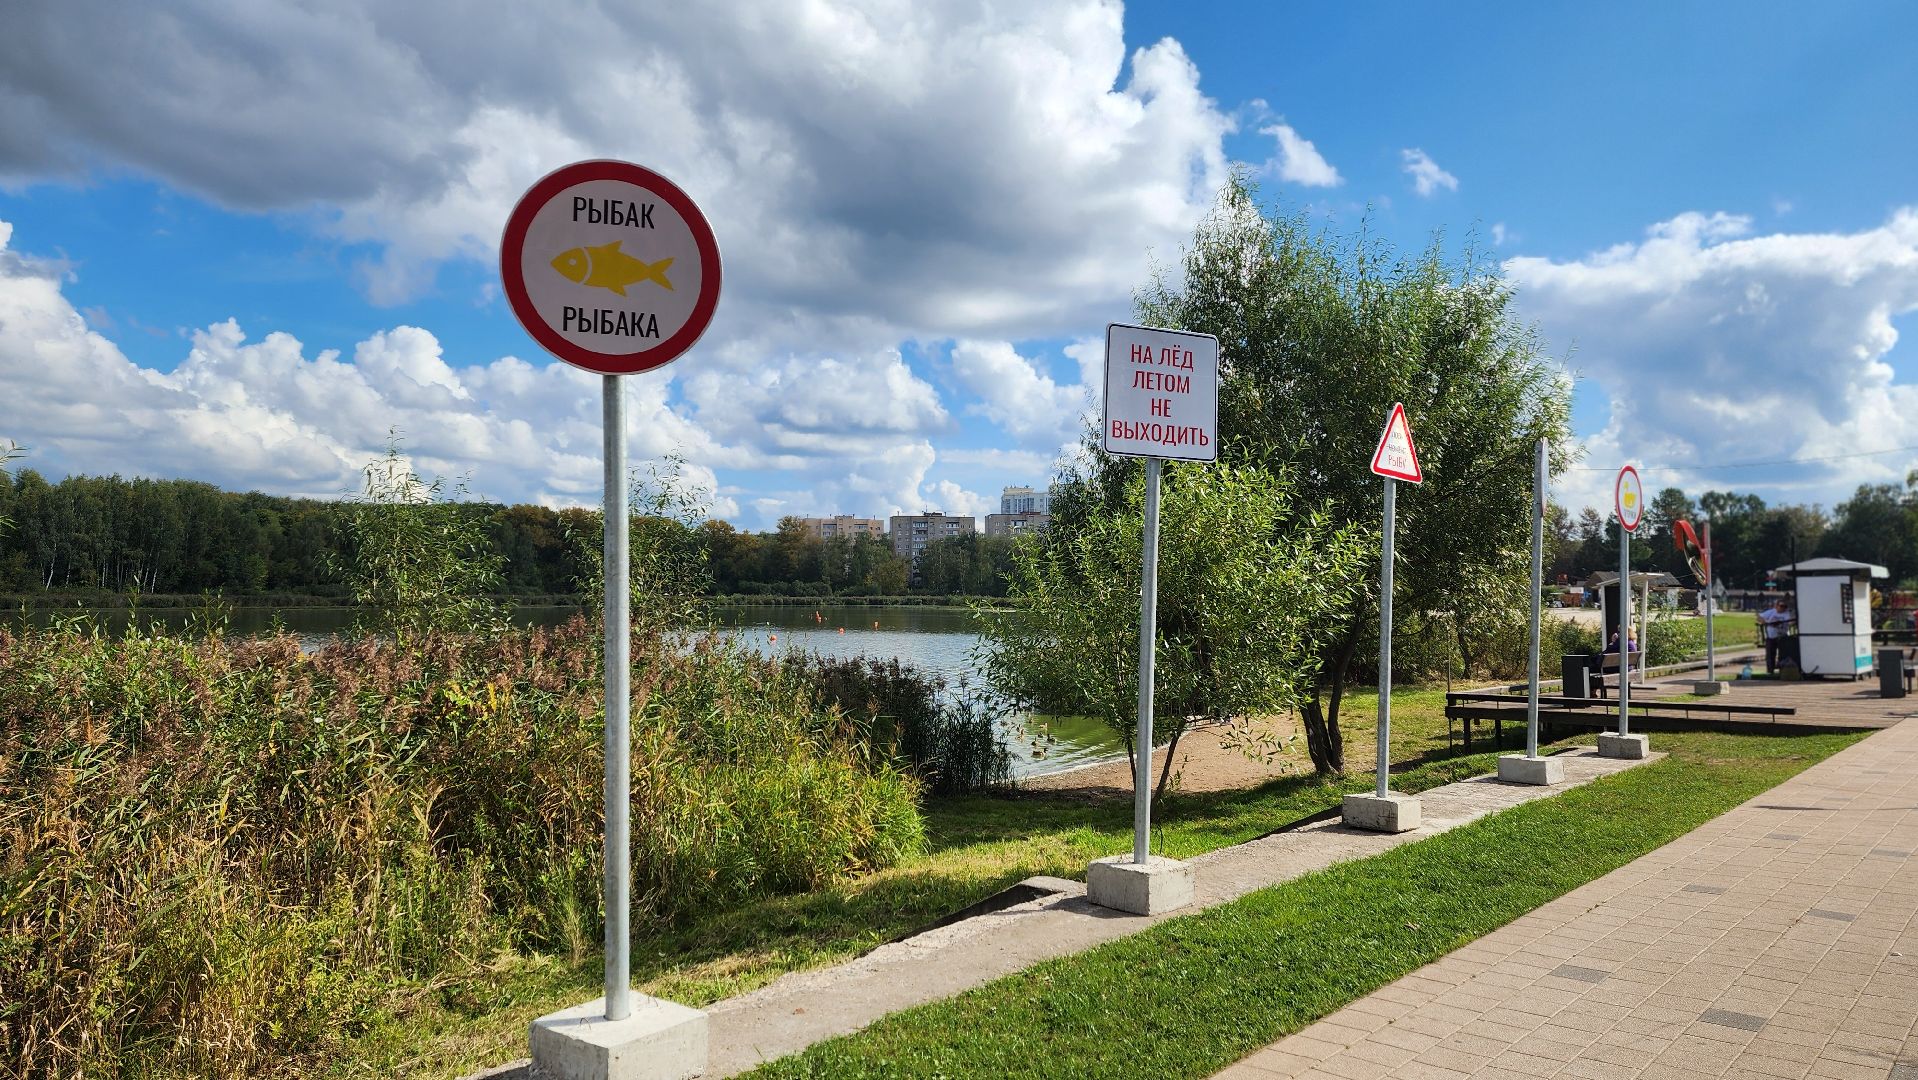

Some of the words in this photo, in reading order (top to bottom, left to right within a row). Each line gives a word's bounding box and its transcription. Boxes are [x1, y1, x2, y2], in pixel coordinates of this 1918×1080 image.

[572, 196, 655, 230] РЫБАК
[562, 305, 660, 339] РЫБАКА
[1130, 343, 1153, 365] НА
[1158, 344, 1194, 372] ЛЁД
[1132, 370, 1190, 394] ЛЕТОМ
[1151, 398, 1172, 418] НЕ
[1111, 420, 1209, 446] ВЫХОДИТЬ
